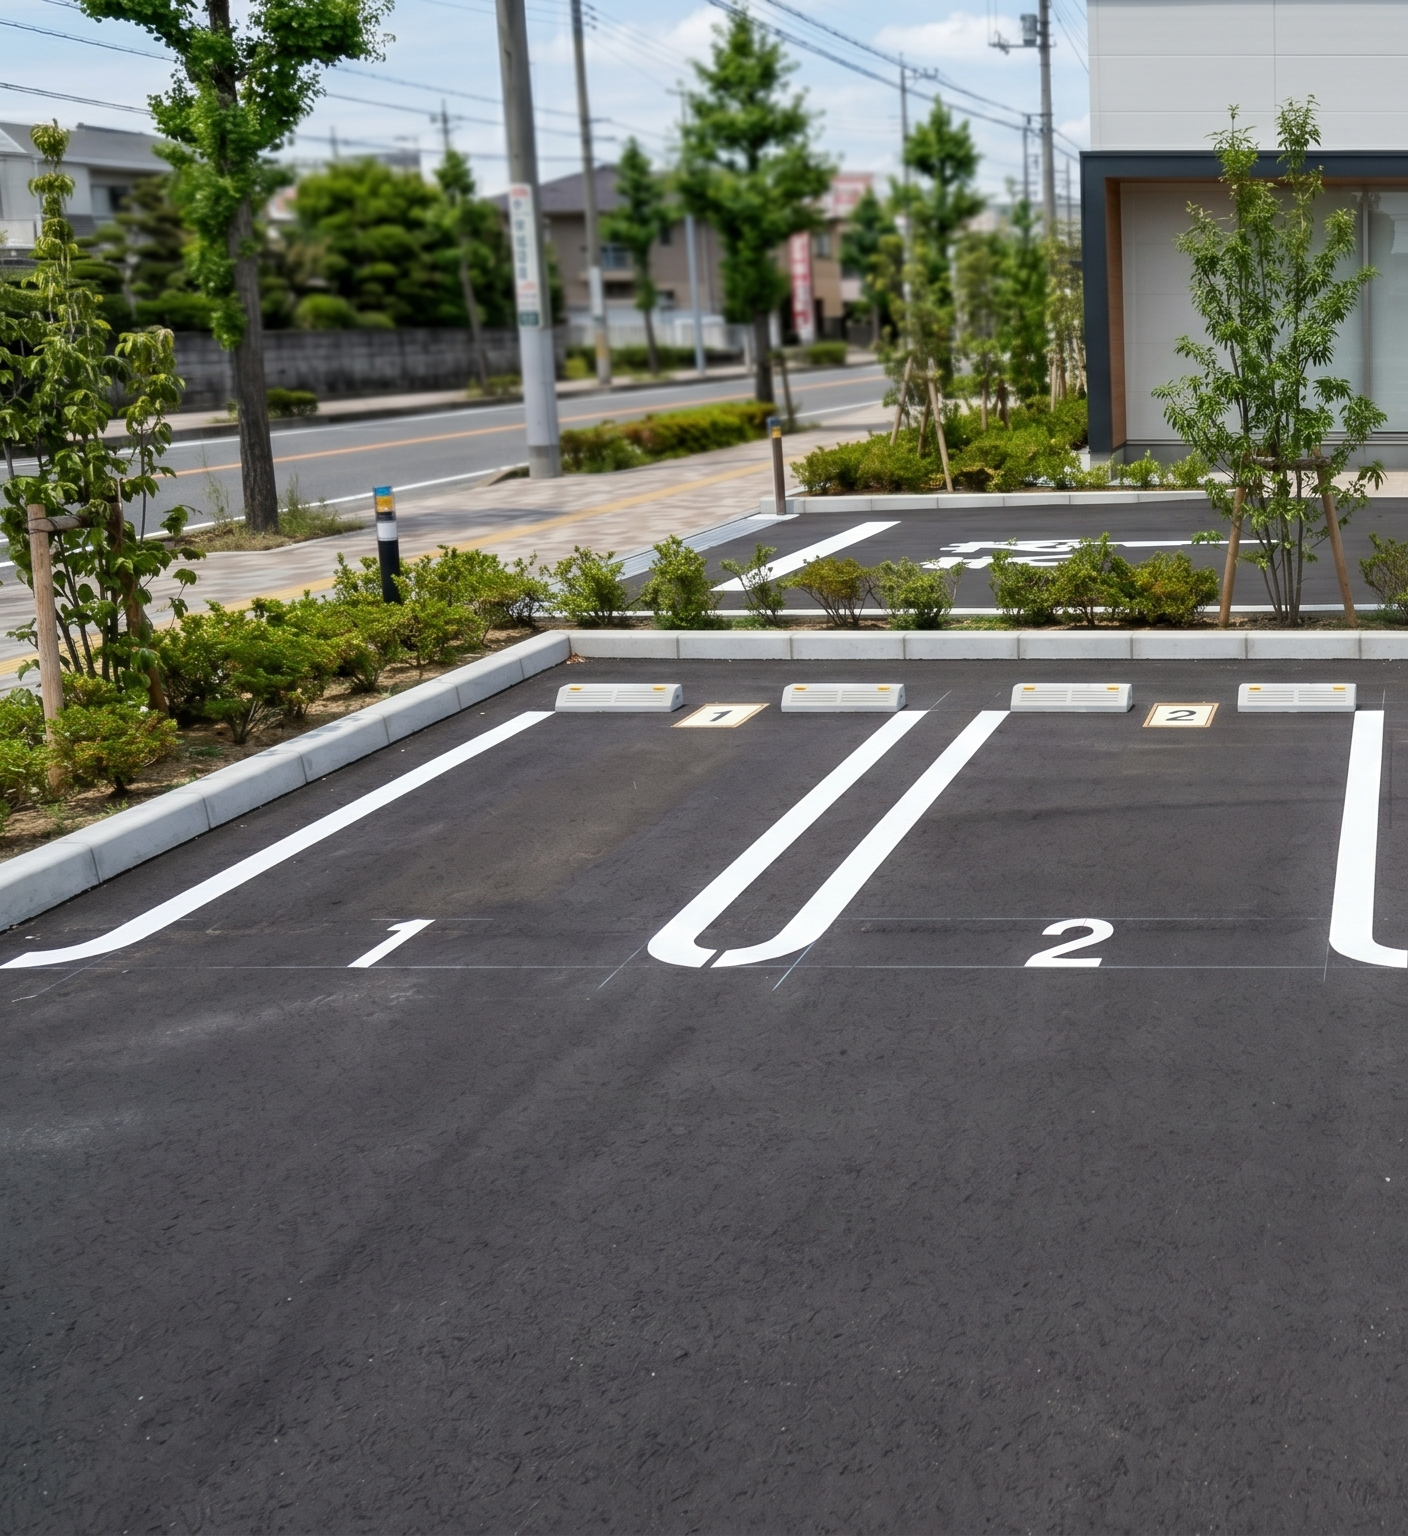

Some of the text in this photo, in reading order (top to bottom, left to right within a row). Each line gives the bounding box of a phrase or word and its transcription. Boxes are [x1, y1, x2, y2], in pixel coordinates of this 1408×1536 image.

[710, 710, 733, 722] 1
[1165, 709, 1197, 721] 2
[347, 918, 435, 968] 1
[1024, 917, 1114, 968] 2
